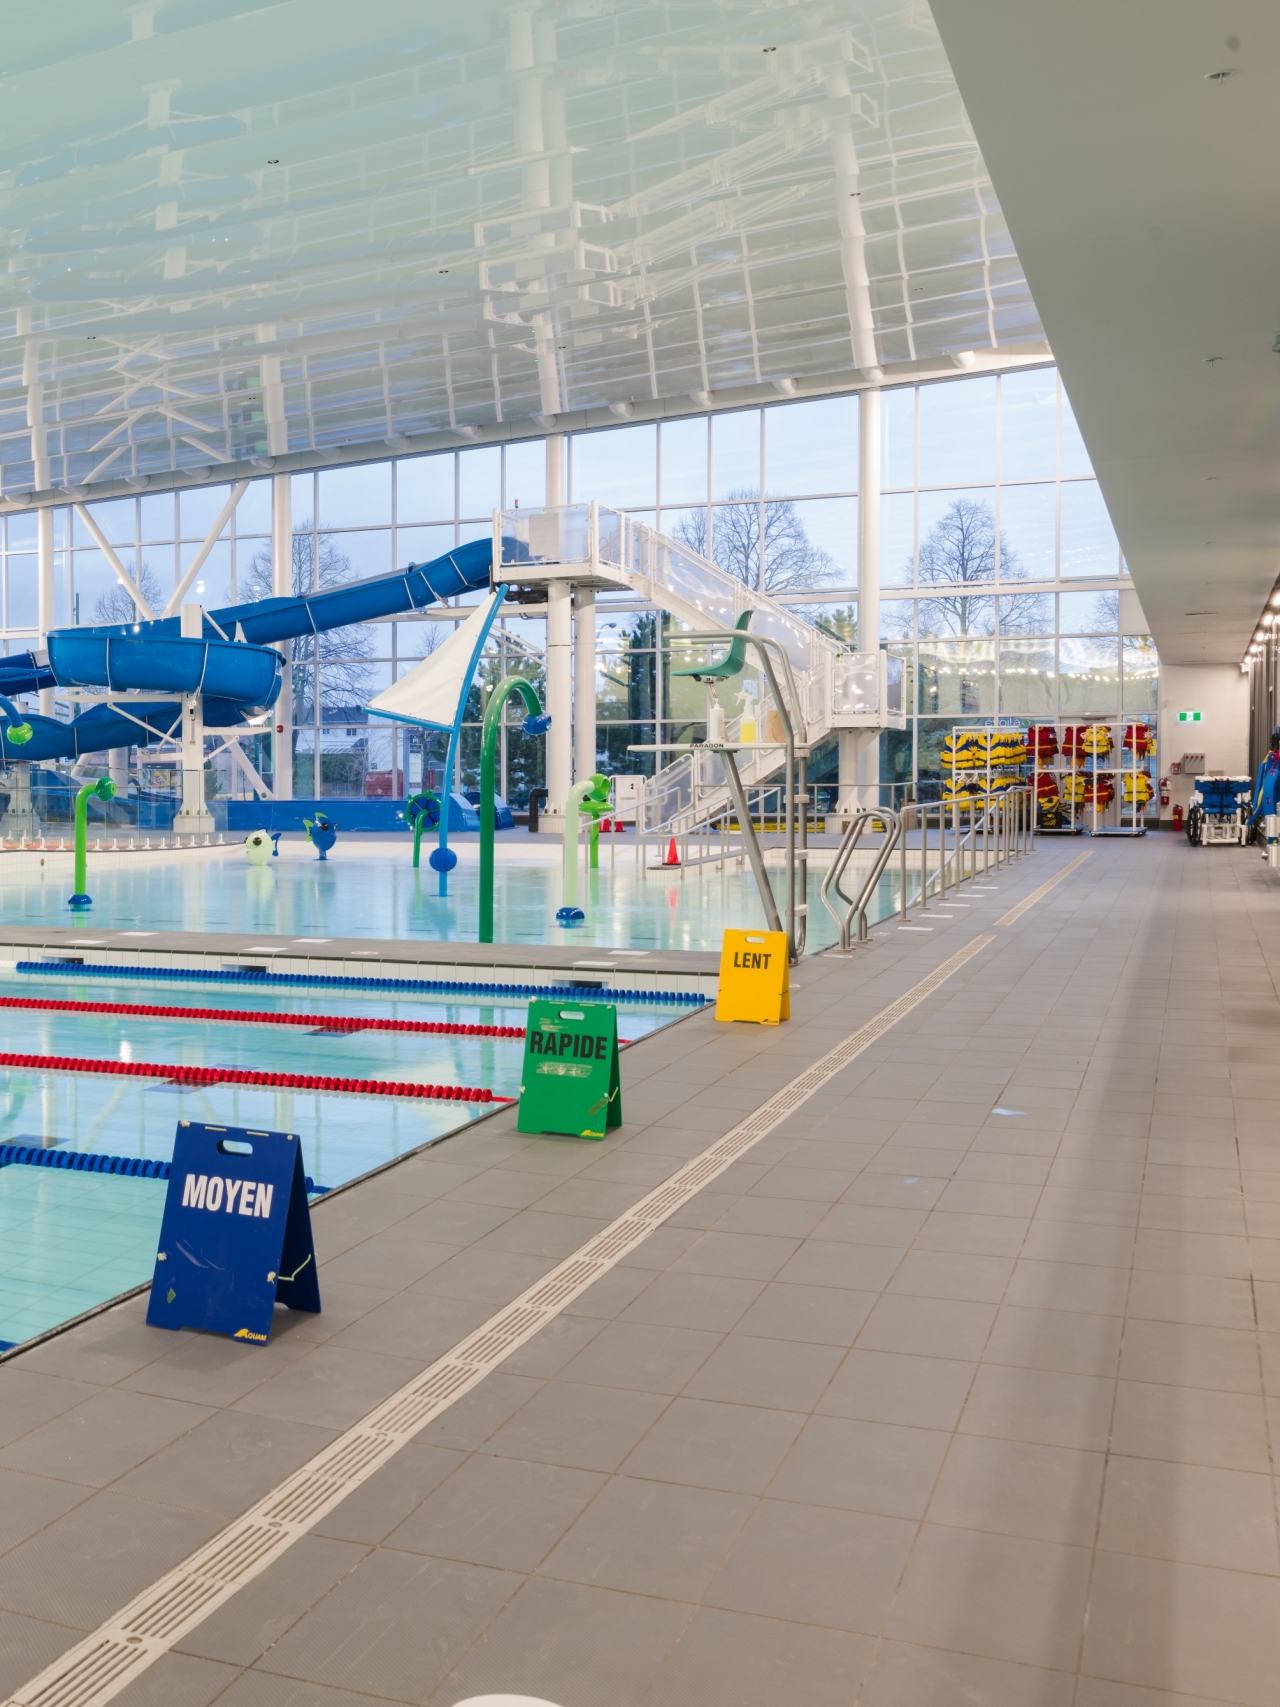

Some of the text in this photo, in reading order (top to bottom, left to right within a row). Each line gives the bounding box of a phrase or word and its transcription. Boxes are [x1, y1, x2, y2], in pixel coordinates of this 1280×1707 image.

[733, 951, 772, 970] LENT
[529, 1030, 608, 1060] RAPIDE
[182, 1173, 274, 1218] MOYEN
